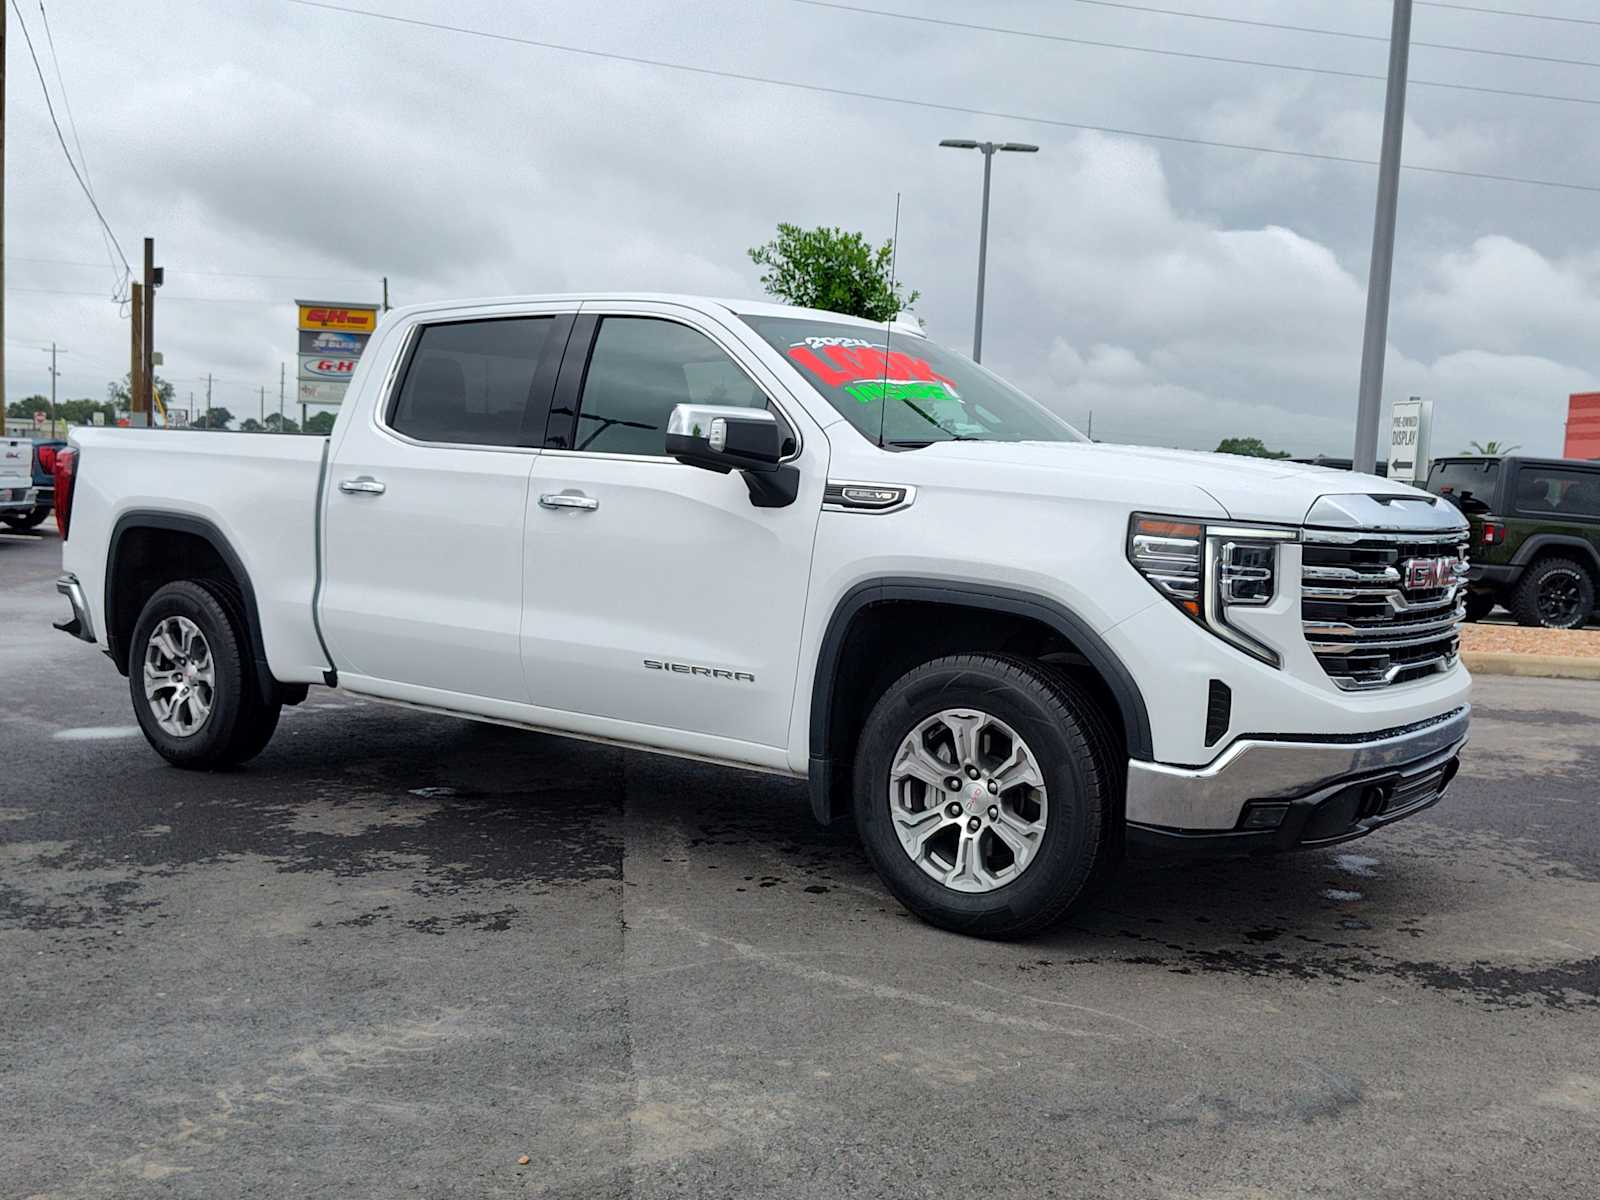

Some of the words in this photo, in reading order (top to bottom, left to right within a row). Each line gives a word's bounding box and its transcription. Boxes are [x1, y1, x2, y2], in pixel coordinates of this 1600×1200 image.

[804, 336, 872, 349] 2024
[787, 345, 958, 388] LOOK
[1392, 430, 1416, 446] DISPLAY
[875, 491, 893, 499] V8
[1405, 556, 1458, 590] GMC
[643, 659, 755, 682] SIERRA
